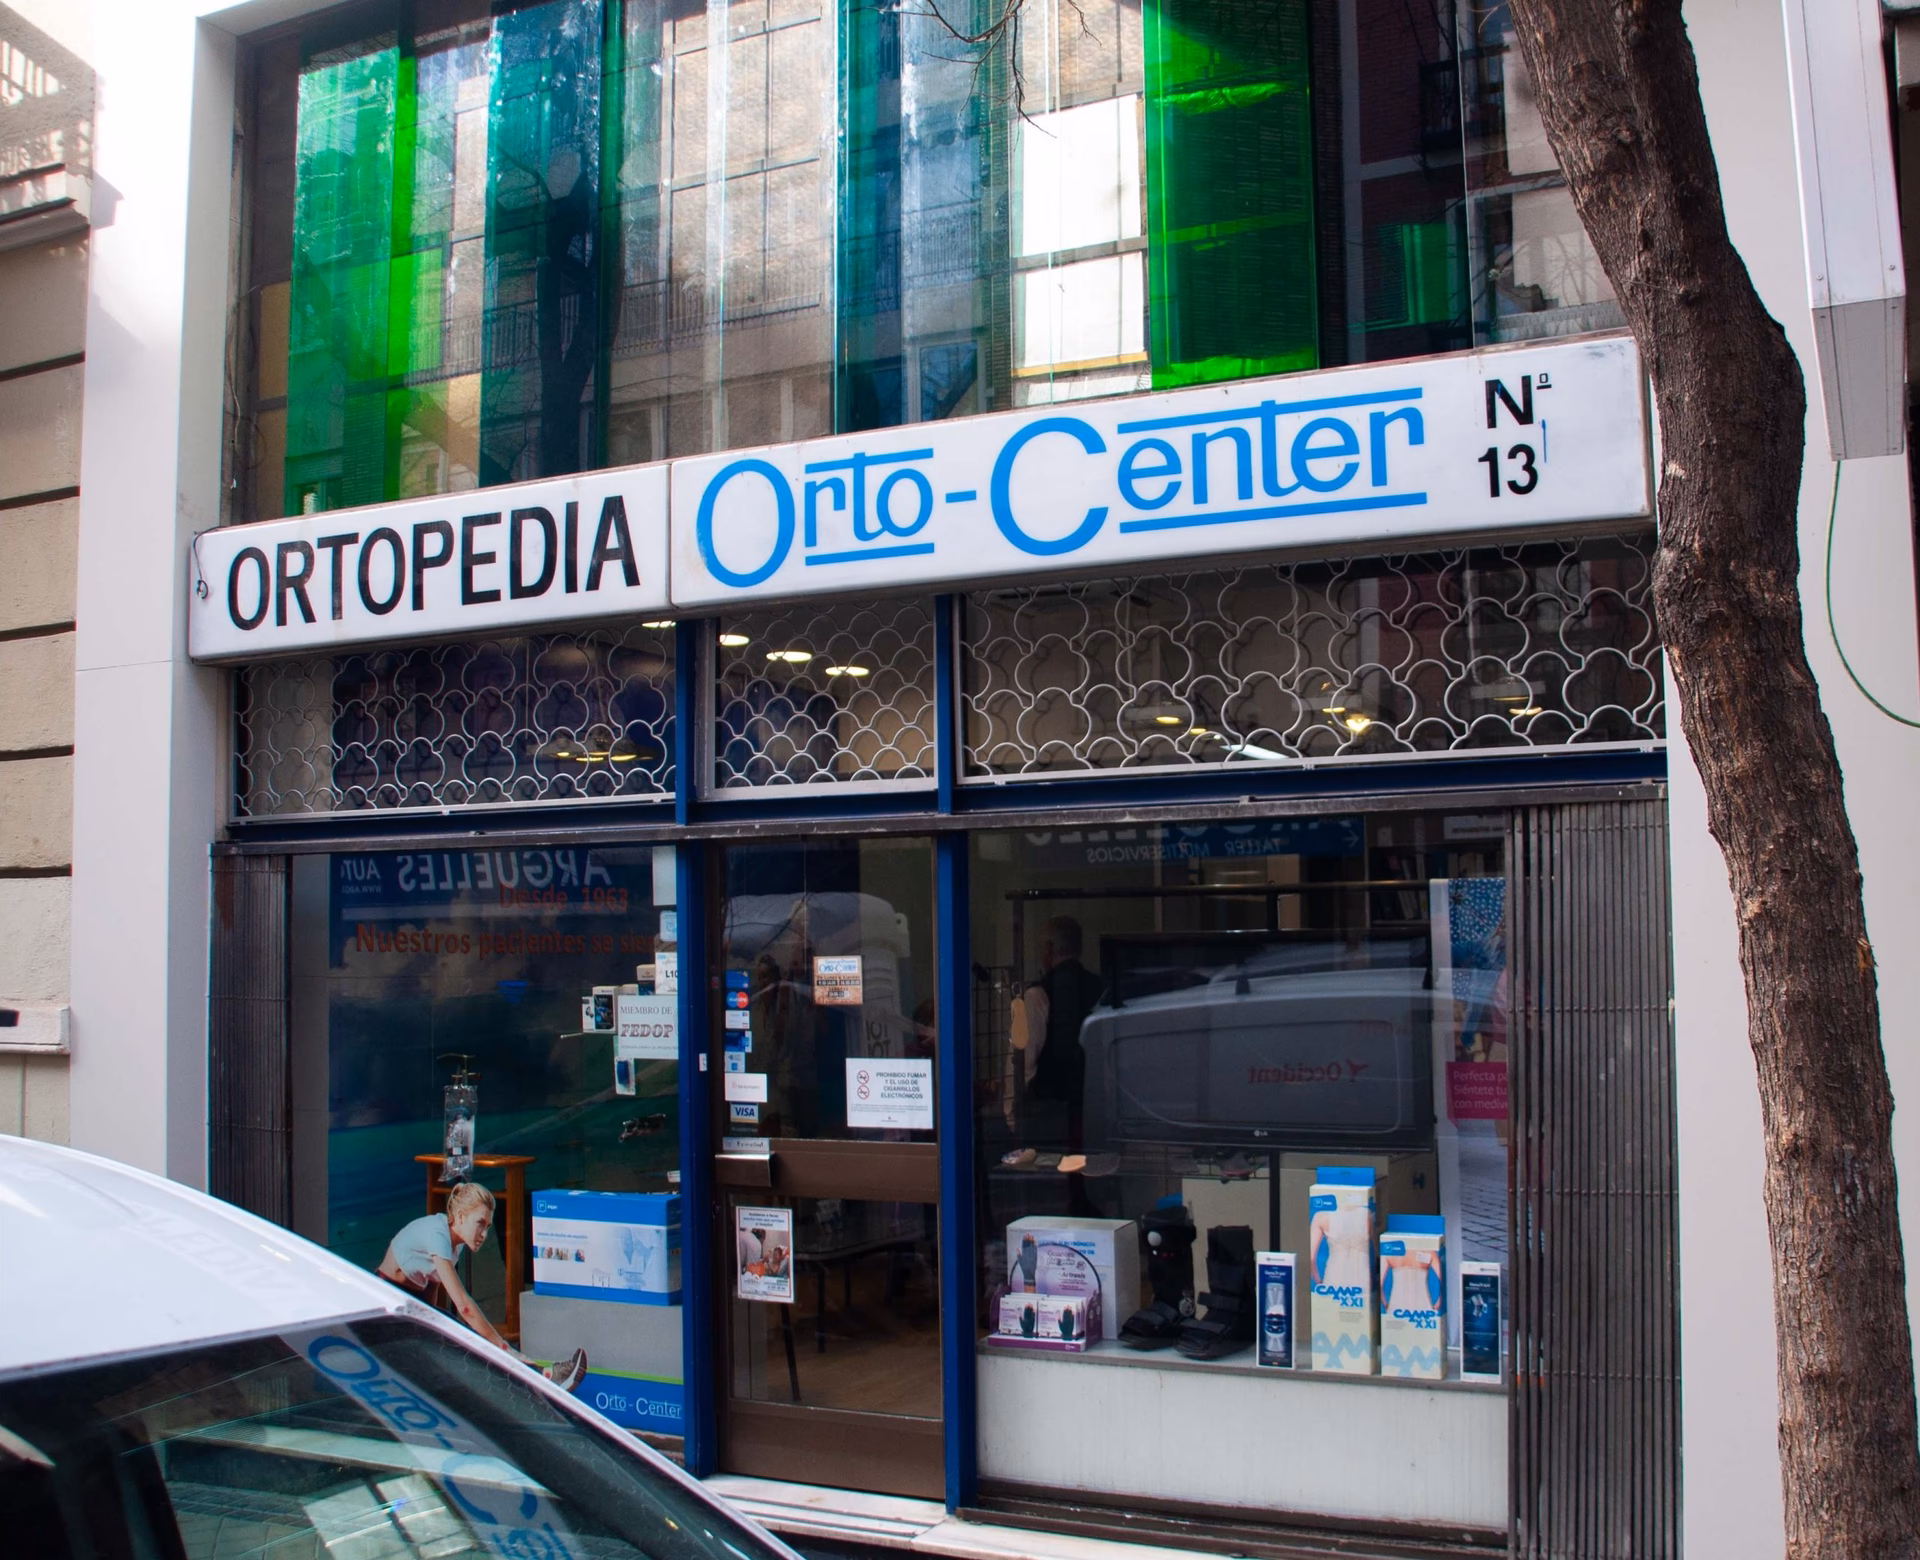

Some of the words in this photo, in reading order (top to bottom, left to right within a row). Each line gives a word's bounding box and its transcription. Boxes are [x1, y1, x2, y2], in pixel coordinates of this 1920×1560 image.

[1478, 443, 1538, 497] 13
[227, 495, 641, 631] ORTOPEDIA
[500, 884, 568, 911] Desde
[581, 886, 629, 912] 1963
[356, 922, 471, 954] Nuestros
[479, 928, 585, 960] pacientes
[591, 936, 613, 954] se
[620, 1006, 660, 1015] MIEMBRO
[661, 1006, 673, 1015] DE
[620, 1023, 674, 1039] FEDOP
[1453, 1070, 1495, 1082] Perfecta
[1453, 1084, 1494, 1096] Siéntete
[1454, 1099, 1472, 1109] con
[734, 1106, 756, 1117] VISA
[1316, 1285, 1363, 1300] CAMP
[1340, 1297, 1364, 1307] XXI
[1393, 1308, 1436, 1322] CAMP
[1415, 1320, 1436, 1329] XXI
